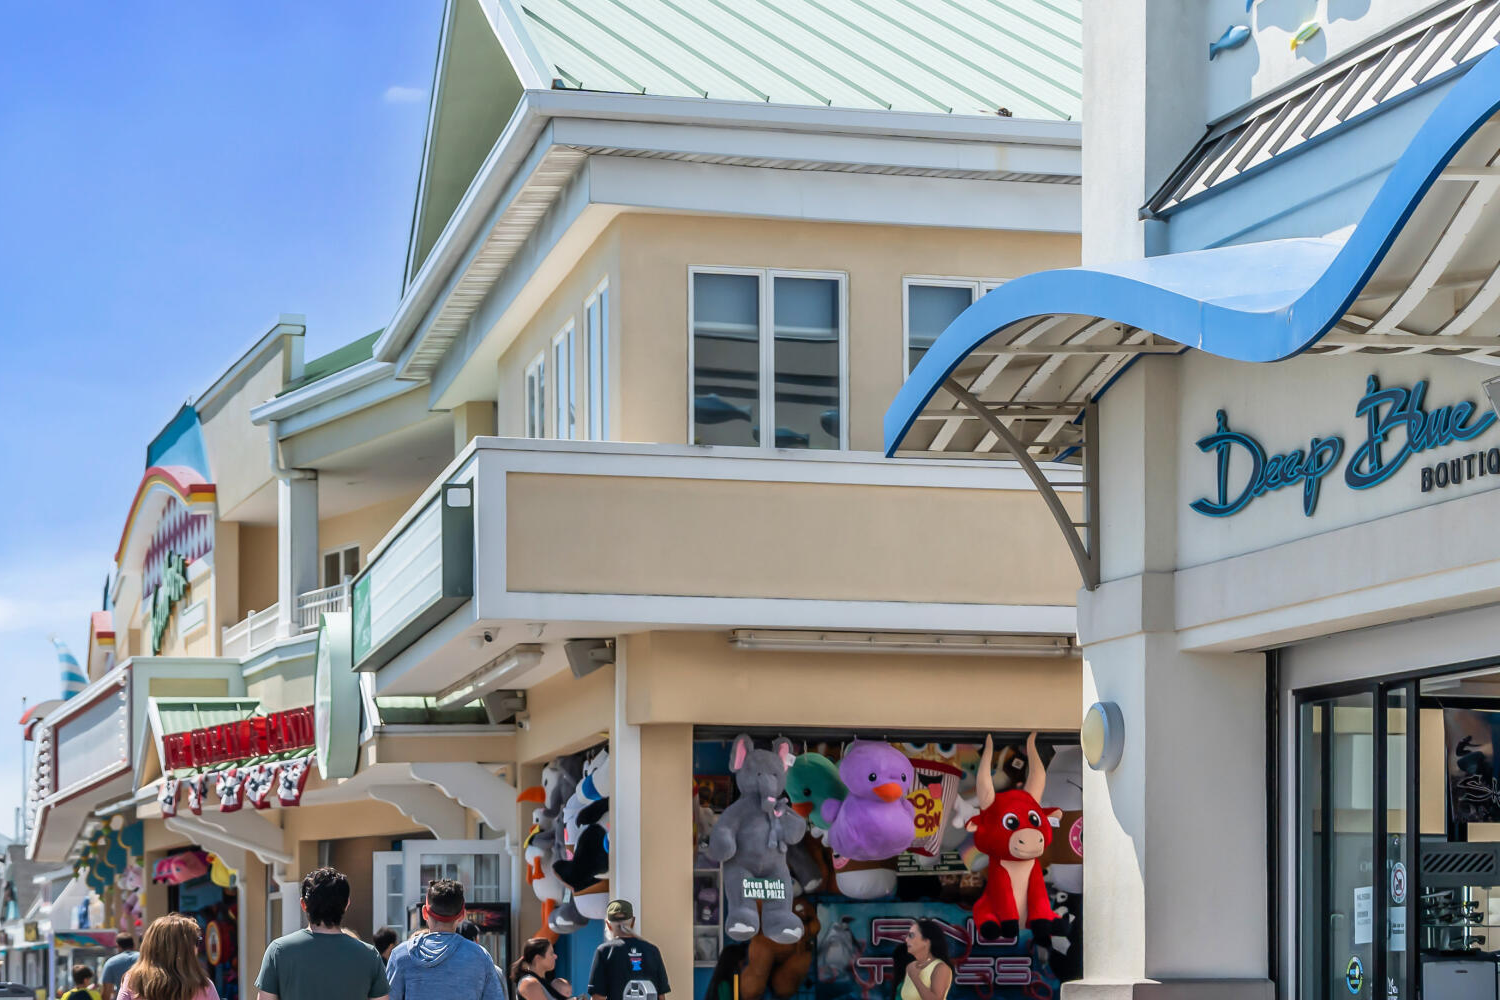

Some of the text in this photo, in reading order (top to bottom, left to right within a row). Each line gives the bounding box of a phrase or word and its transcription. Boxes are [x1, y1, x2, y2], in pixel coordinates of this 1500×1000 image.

[1189, 374, 1499, 517] Deep Blue
[1421, 448, 1500, 492] BOUTIQ
[907, 793, 935, 814] OP
[914, 811, 941, 832] ORN
